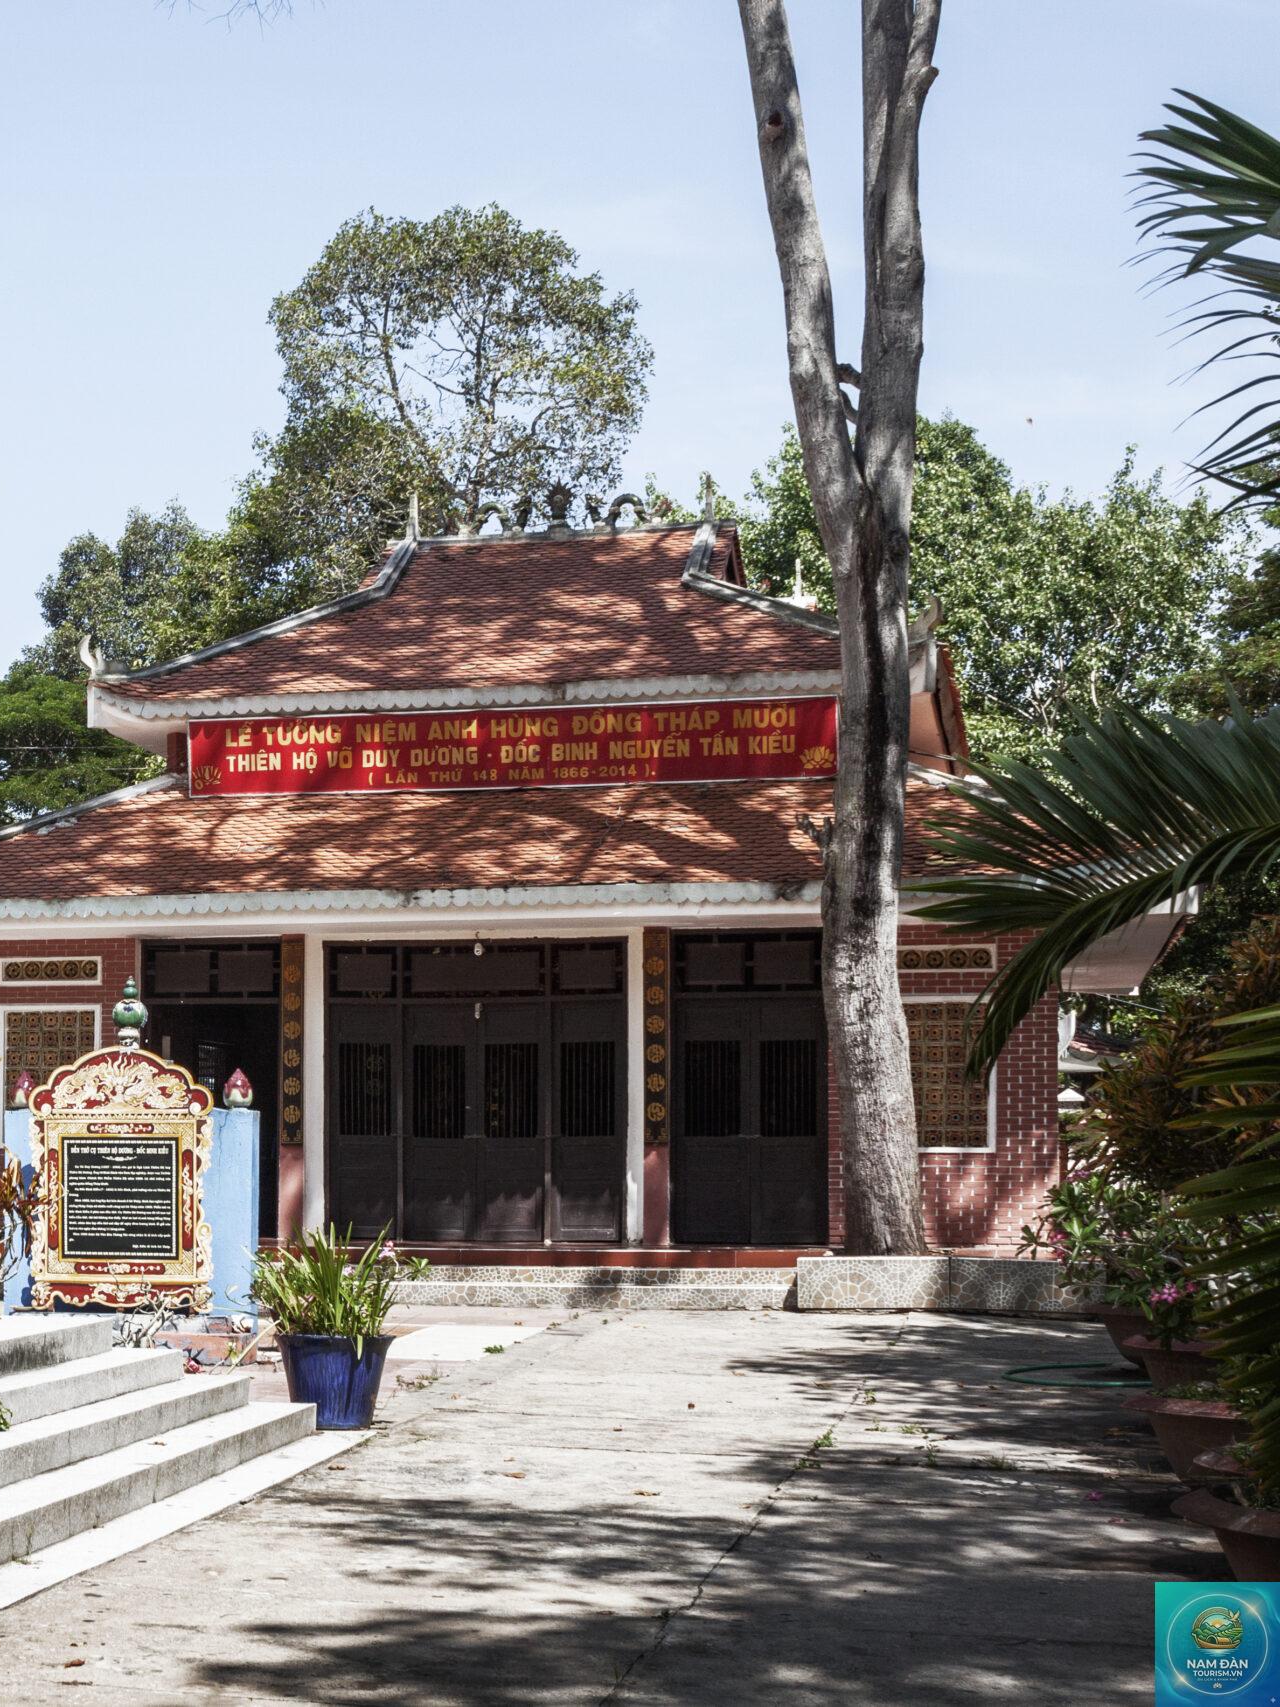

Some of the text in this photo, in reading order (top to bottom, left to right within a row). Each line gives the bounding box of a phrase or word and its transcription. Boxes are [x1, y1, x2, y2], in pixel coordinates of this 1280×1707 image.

[225, 720, 252, 747] LỄ
[262, 719, 342, 746] TƯỞNG
[356, 719, 417, 744] NIỆM
[427, 718, 478, 740] ANH
[491, 713, 559, 739] HÙNG
[572, 708, 642, 735] ĐỒNG
[653, 705, 720, 732] THÁP
[225, 749, 282, 772] THIÊN
[292, 747, 318, 774] HỘ
[326, 746, 353, 769] VÕ
[362, 748, 401, 768] DUY
[410, 745, 479, 767] DƯƠNG
[500, 738, 541, 764] ĐỐC
[551, 741, 598, 762] BINH
[609, 731, 690, 760] NGUYỄN
[699, 729, 739, 756] TẤN
[748, 729, 796, 755] KIỀU
[473, 769, 498, 782] 148
[508, 766, 545, 781] NĂM
